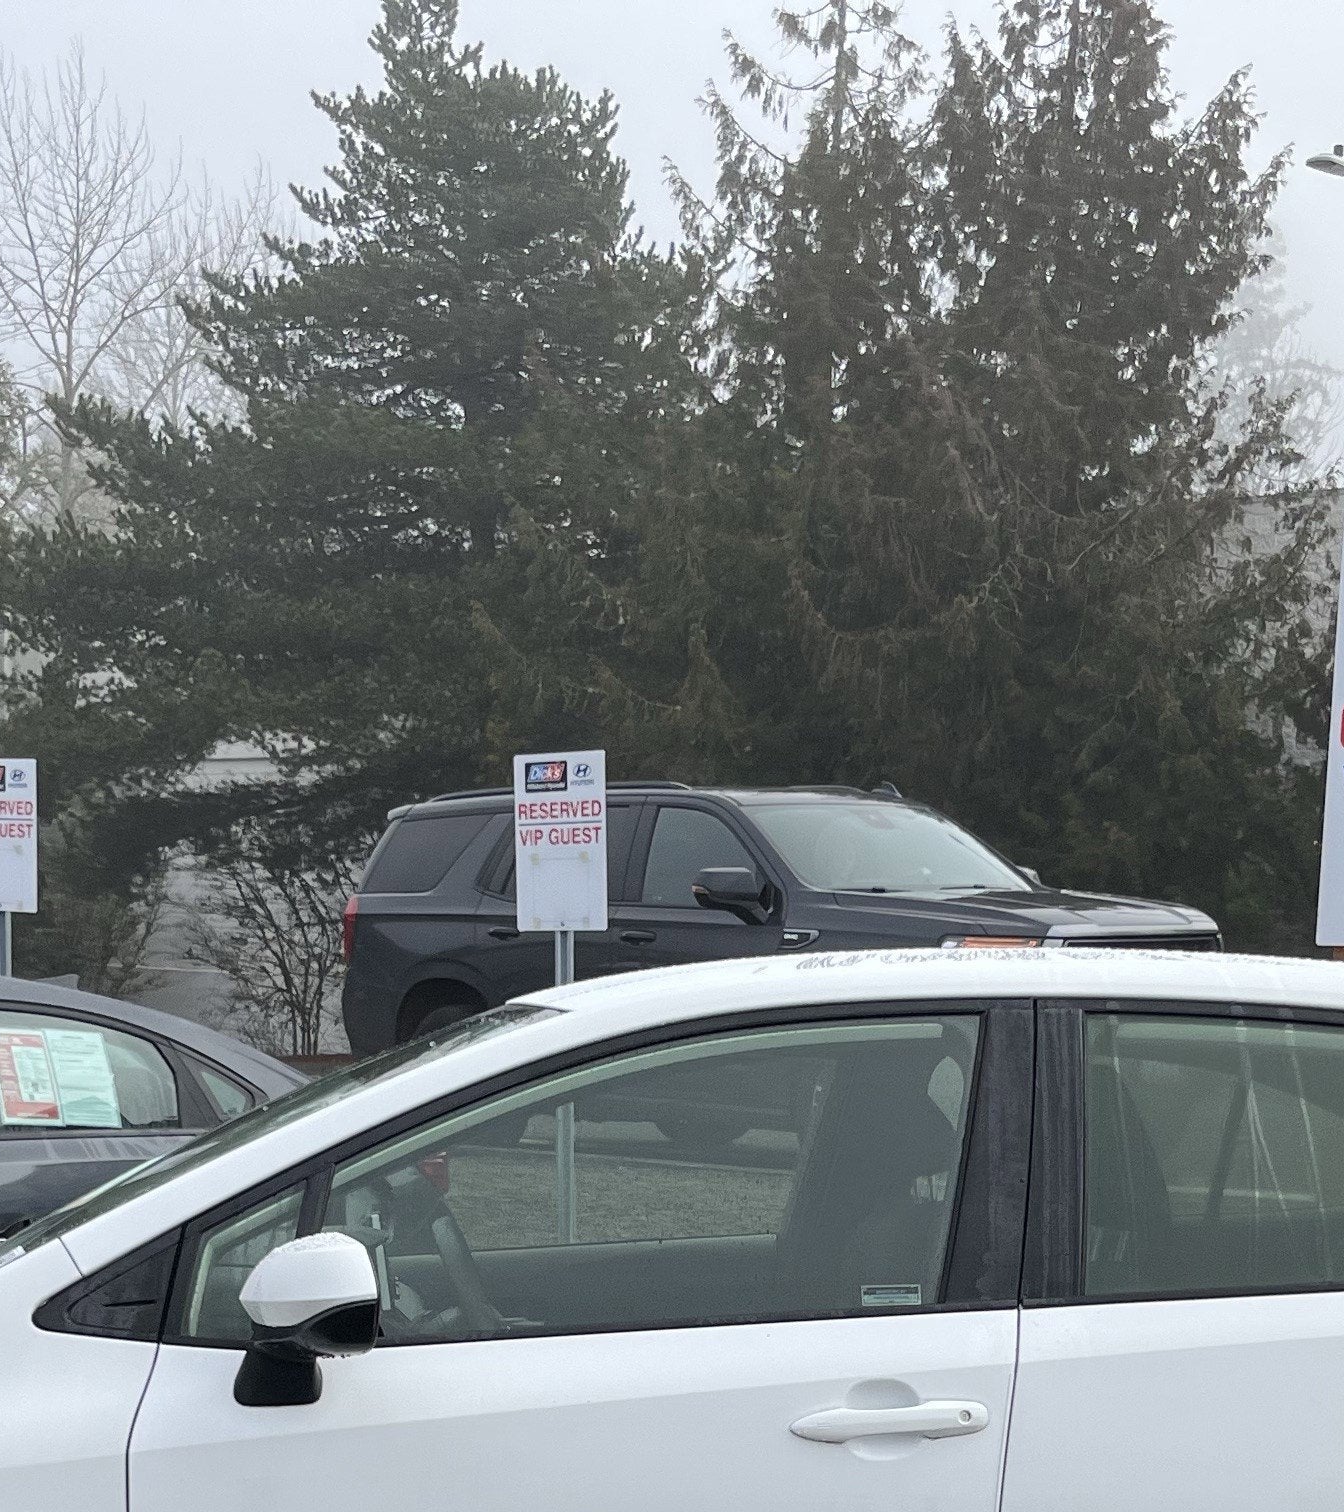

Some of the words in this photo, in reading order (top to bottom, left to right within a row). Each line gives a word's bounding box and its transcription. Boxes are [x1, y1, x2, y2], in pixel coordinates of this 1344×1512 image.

[518, 800, 601, 820] RESERVED
[519, 829, 543, 846] VIP
[549, 826, 601, 845] GUEST
